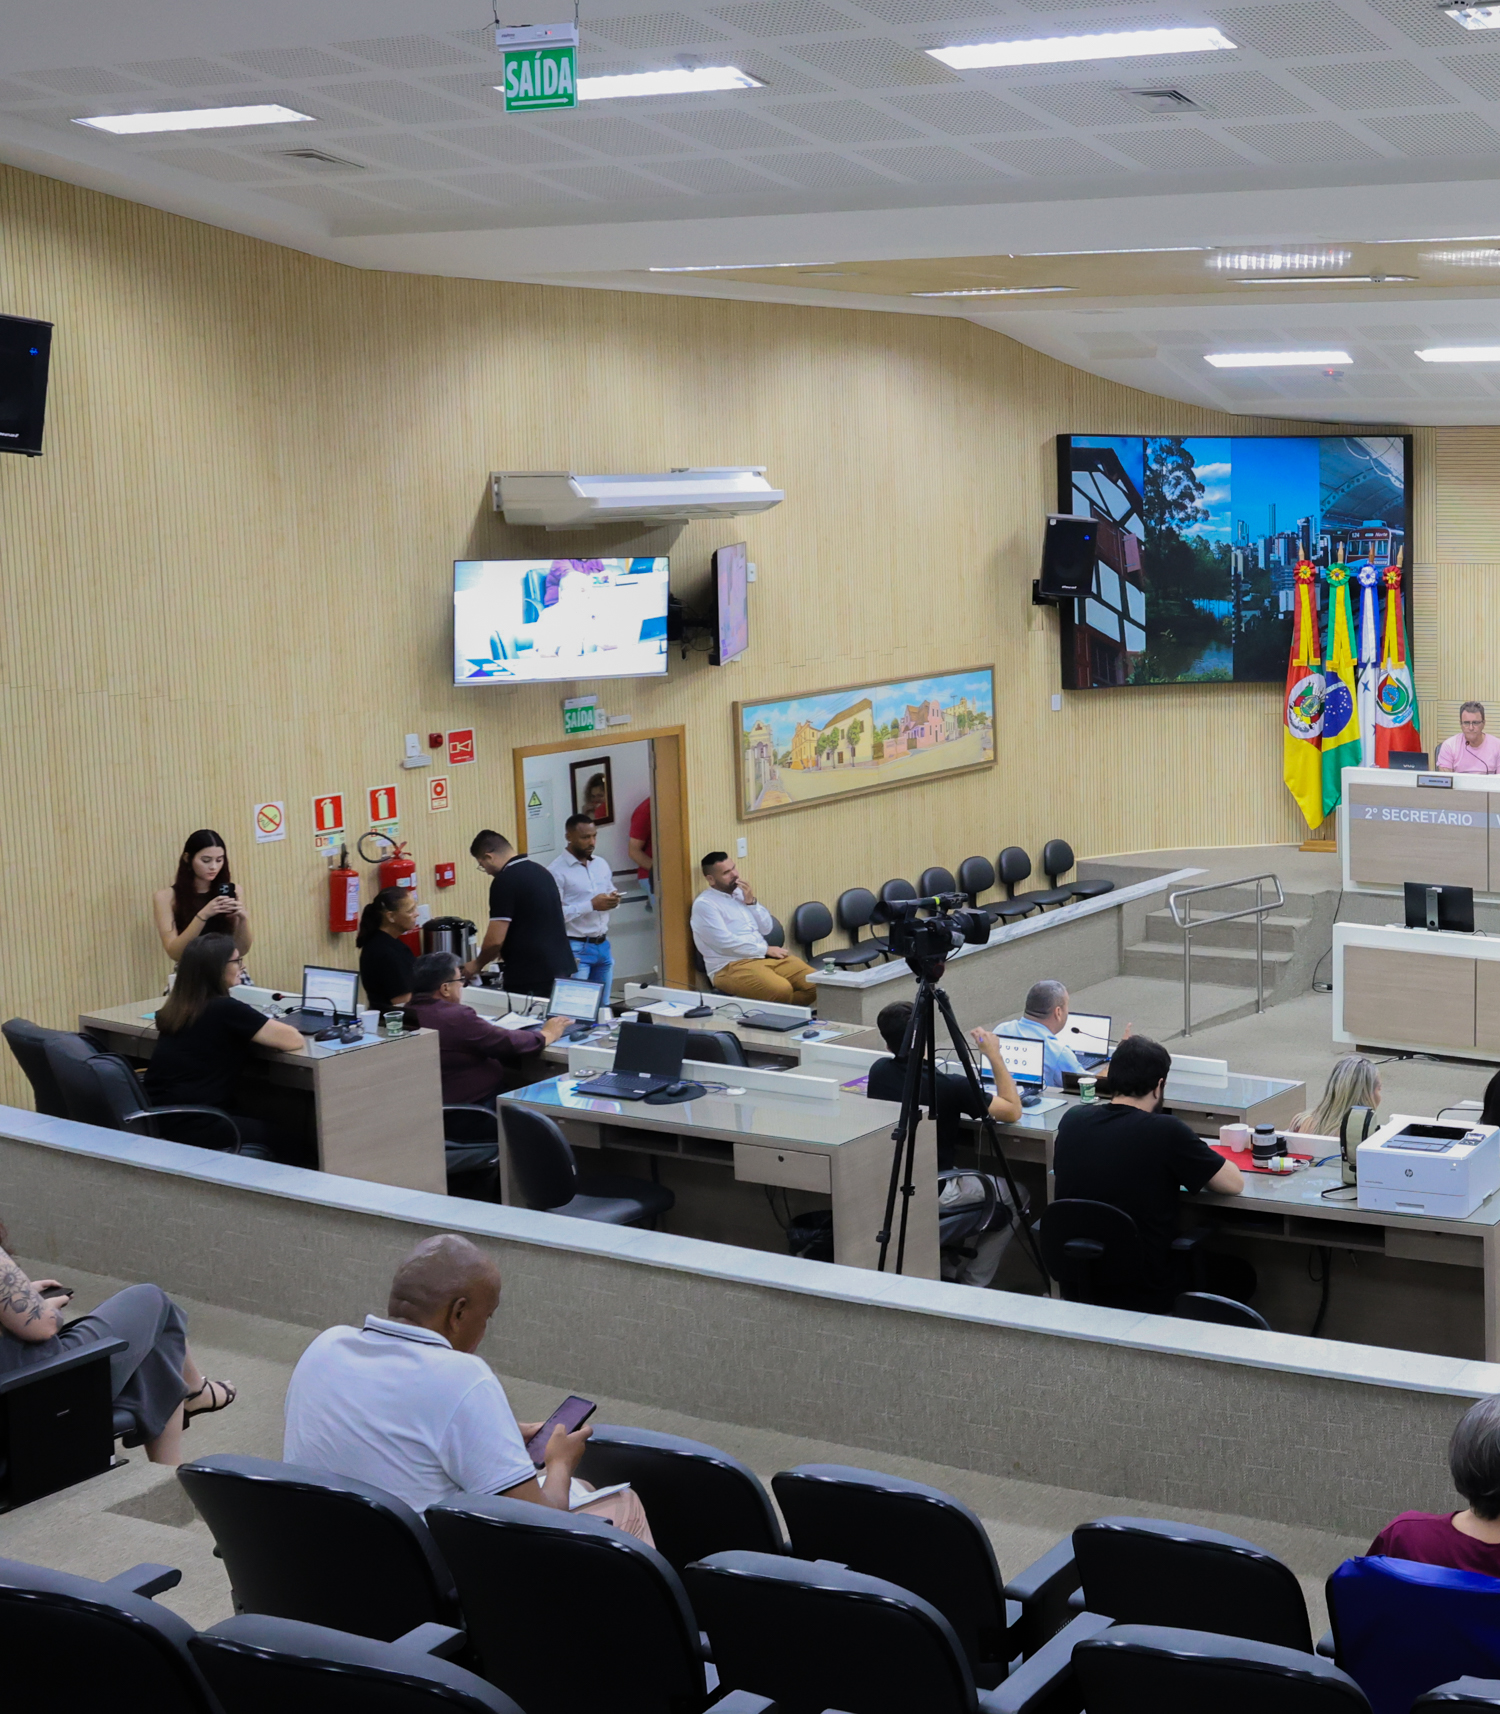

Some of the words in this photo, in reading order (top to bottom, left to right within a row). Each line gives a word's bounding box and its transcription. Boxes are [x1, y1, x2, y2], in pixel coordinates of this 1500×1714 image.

[506, 51, 573, 98] SAÍDA
[565, 707, 593, 729] SAÍDA
[1382, 808, 1473, 826] SECRETÁRIO
